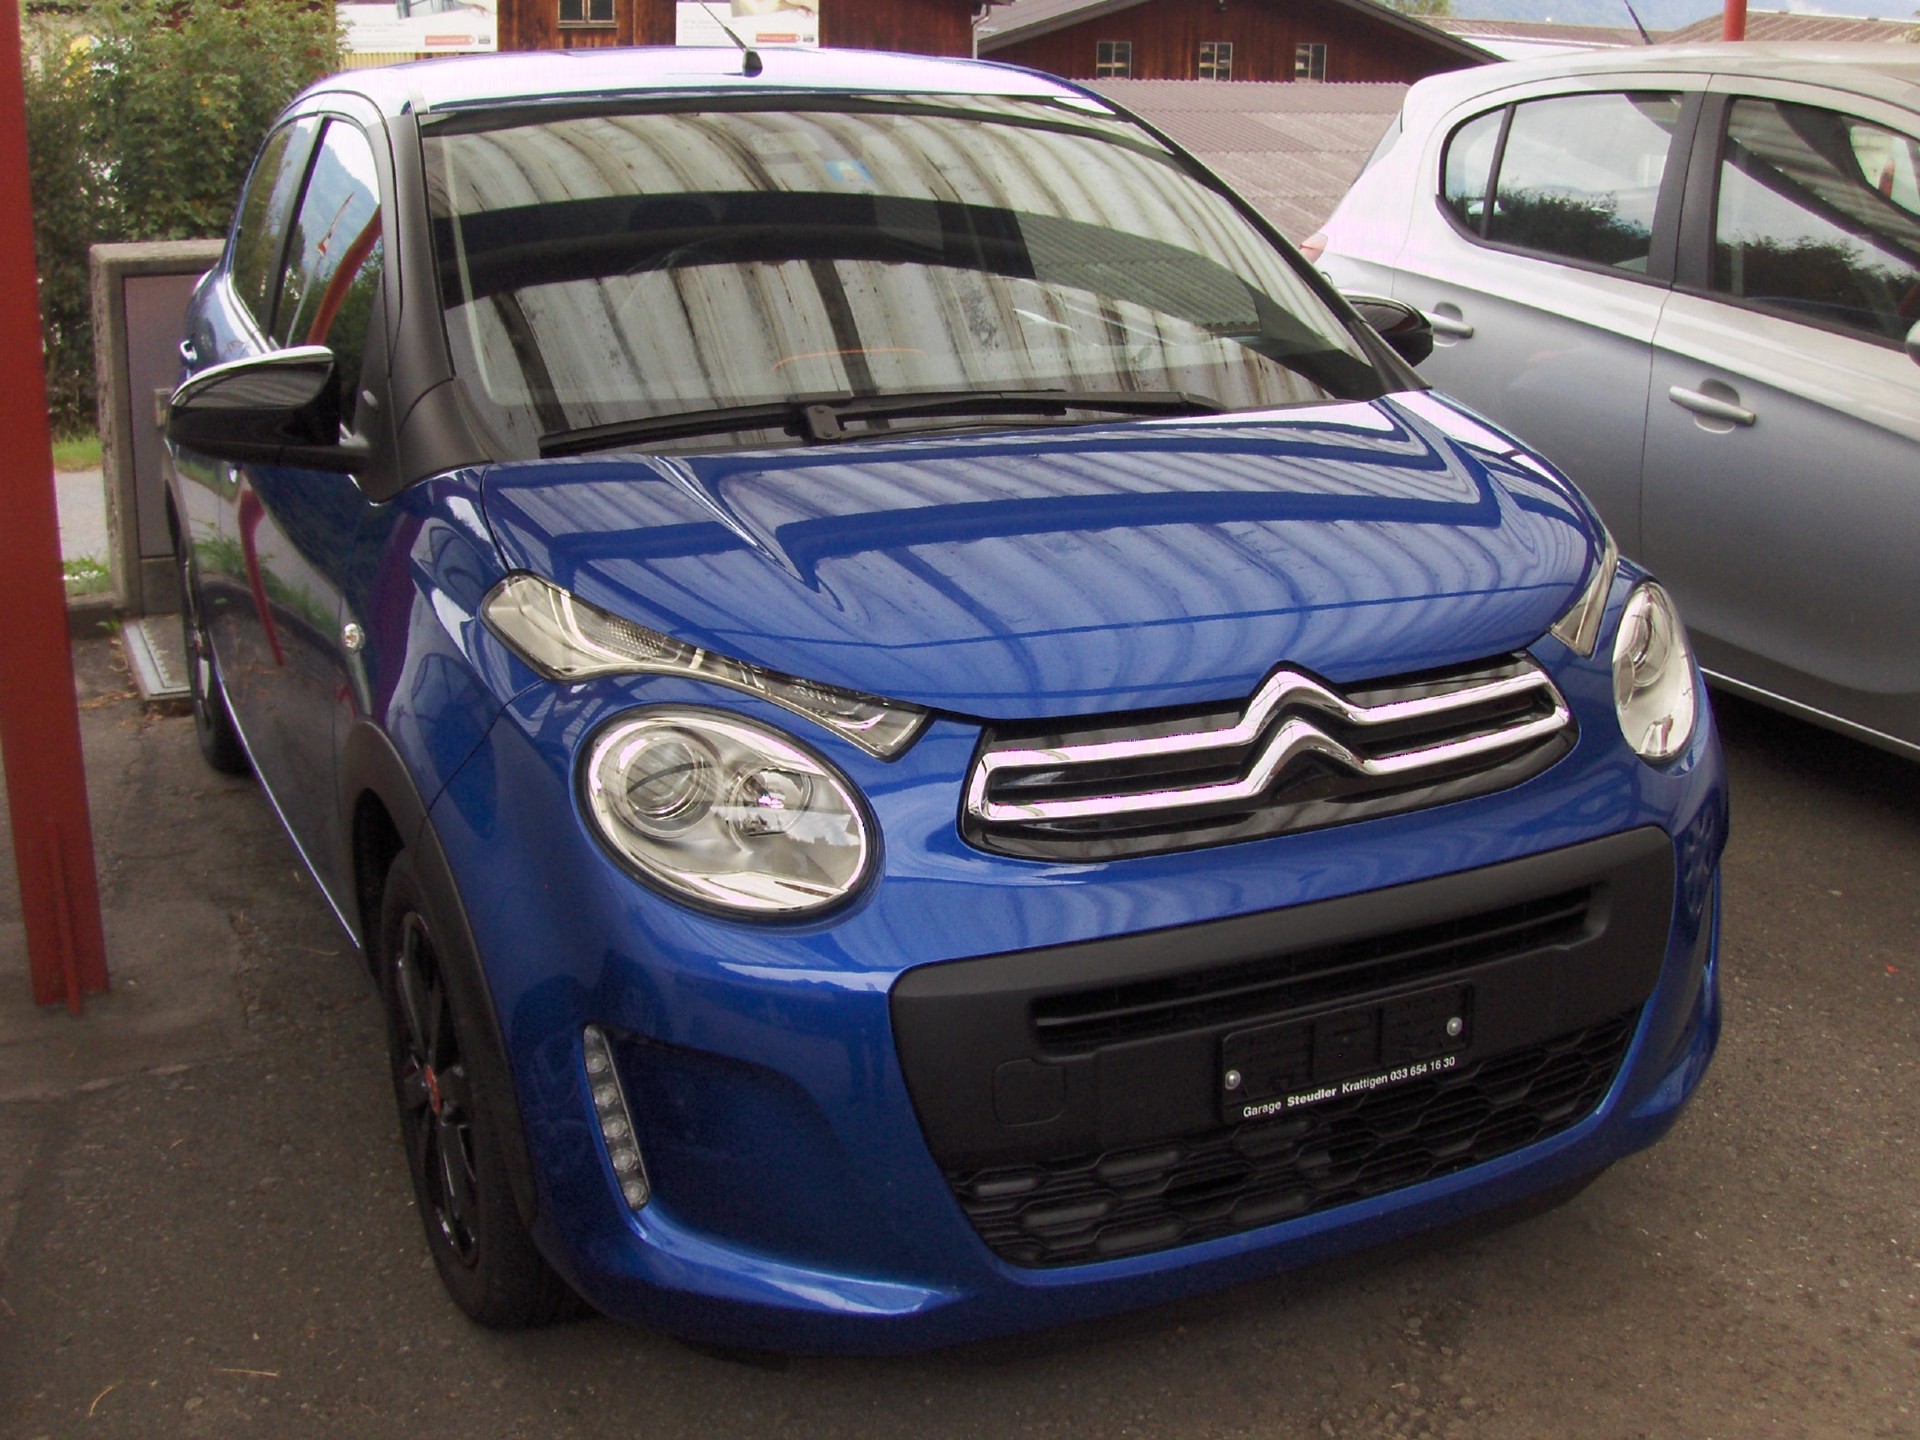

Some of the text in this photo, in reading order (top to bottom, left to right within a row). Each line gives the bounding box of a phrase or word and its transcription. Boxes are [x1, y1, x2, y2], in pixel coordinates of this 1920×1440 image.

[1243, 1056, 1455, 1118] Garage Steudler Krattigen 033 654 16 30
